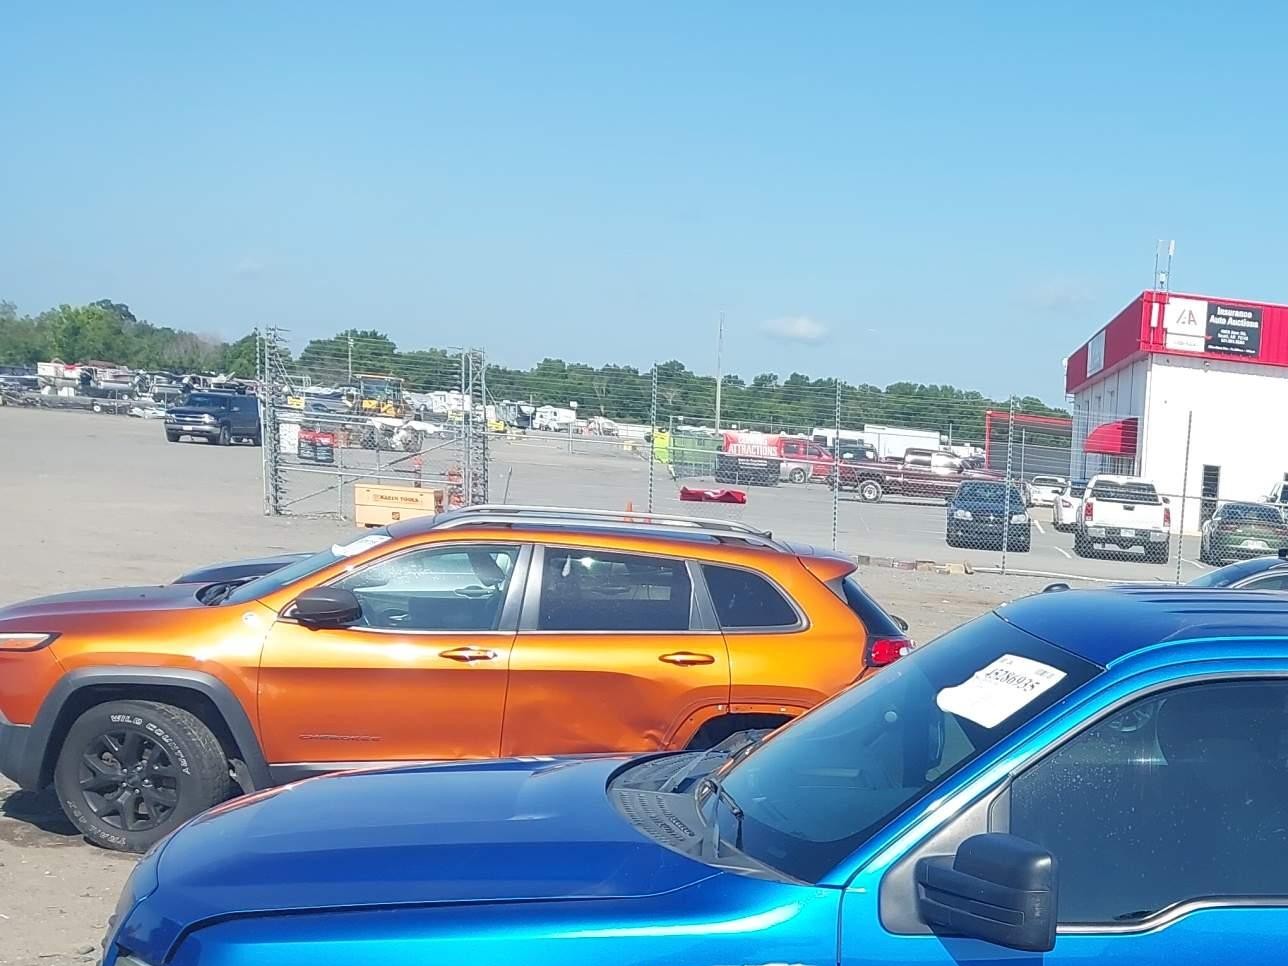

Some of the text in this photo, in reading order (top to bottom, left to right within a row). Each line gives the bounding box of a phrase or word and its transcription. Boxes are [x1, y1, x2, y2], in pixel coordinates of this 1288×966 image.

[1217, 306, 1253, 319] Insurance
[1209, 315, 1259, 329] Auto Auctions
[730, 443, 778, 457] ATTRACTIONS
